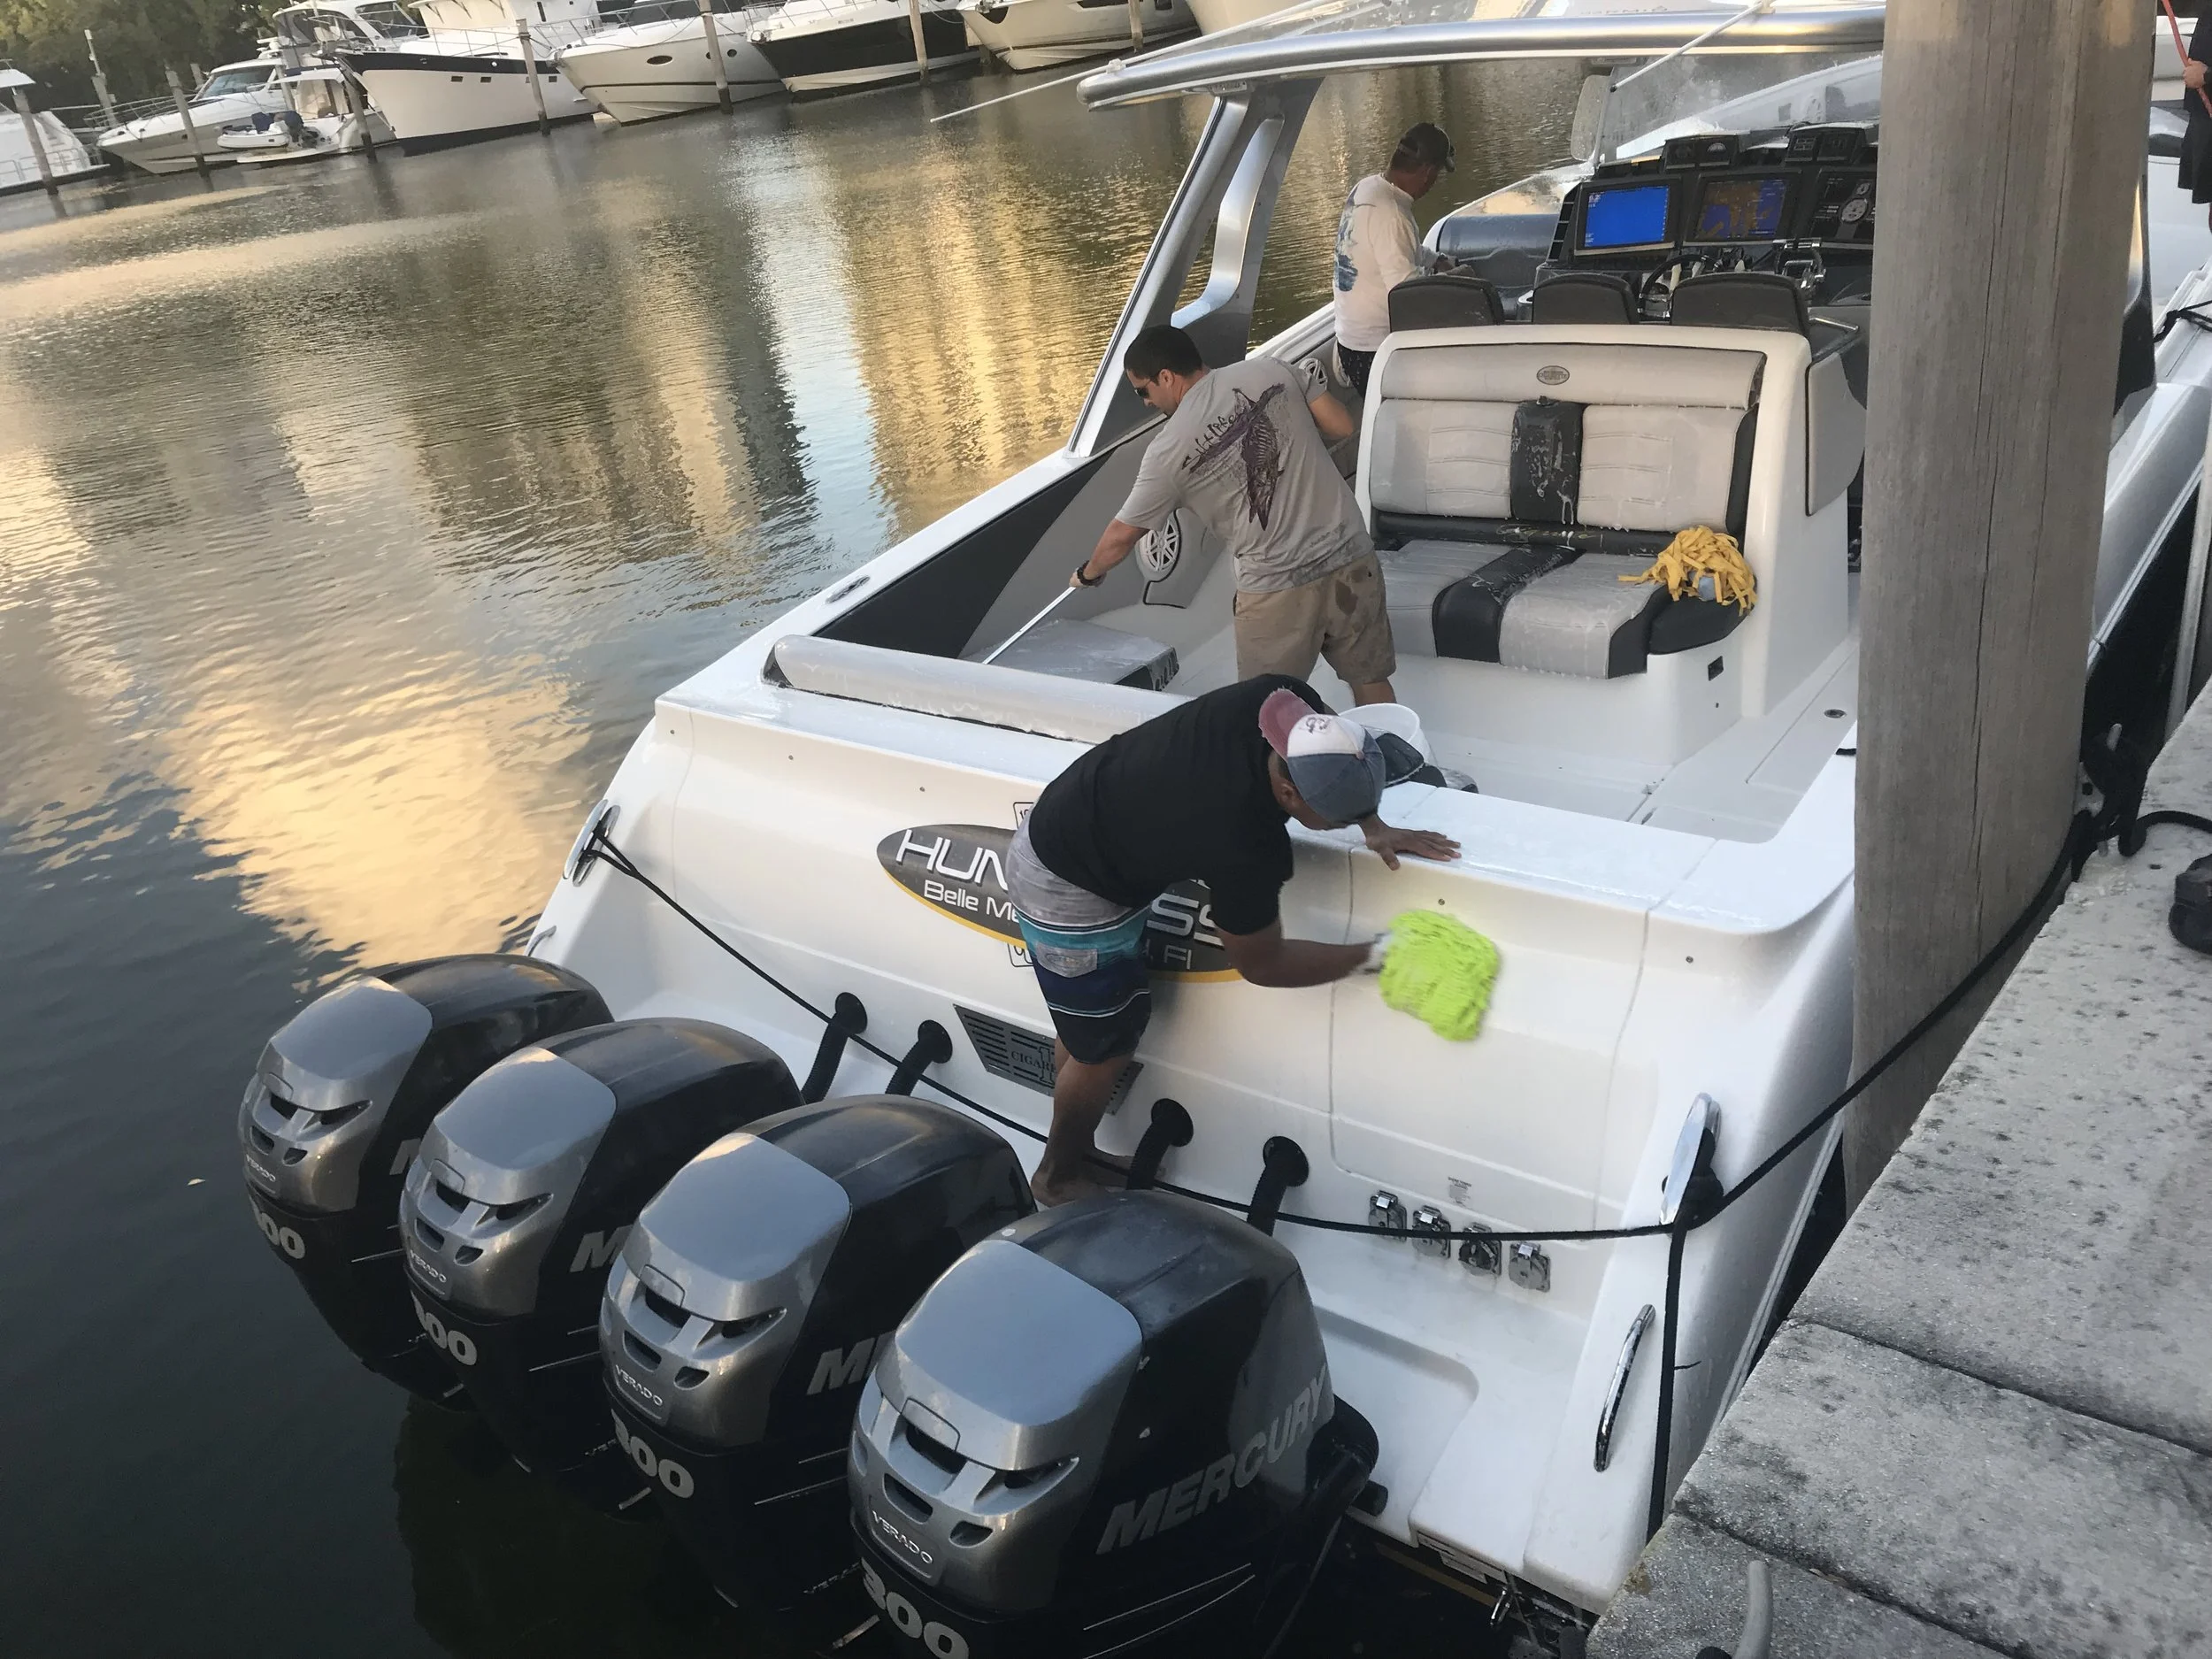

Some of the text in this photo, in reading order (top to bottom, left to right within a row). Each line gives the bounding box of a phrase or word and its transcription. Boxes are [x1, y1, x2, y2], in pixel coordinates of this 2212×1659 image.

[924, 879, 979, 911] Belle
[615, 1363, 664, 1407] VERADO
[1095, 1362, 1327, 1555] MERCURY
[872, 1509, 933, 1564] VERADO
